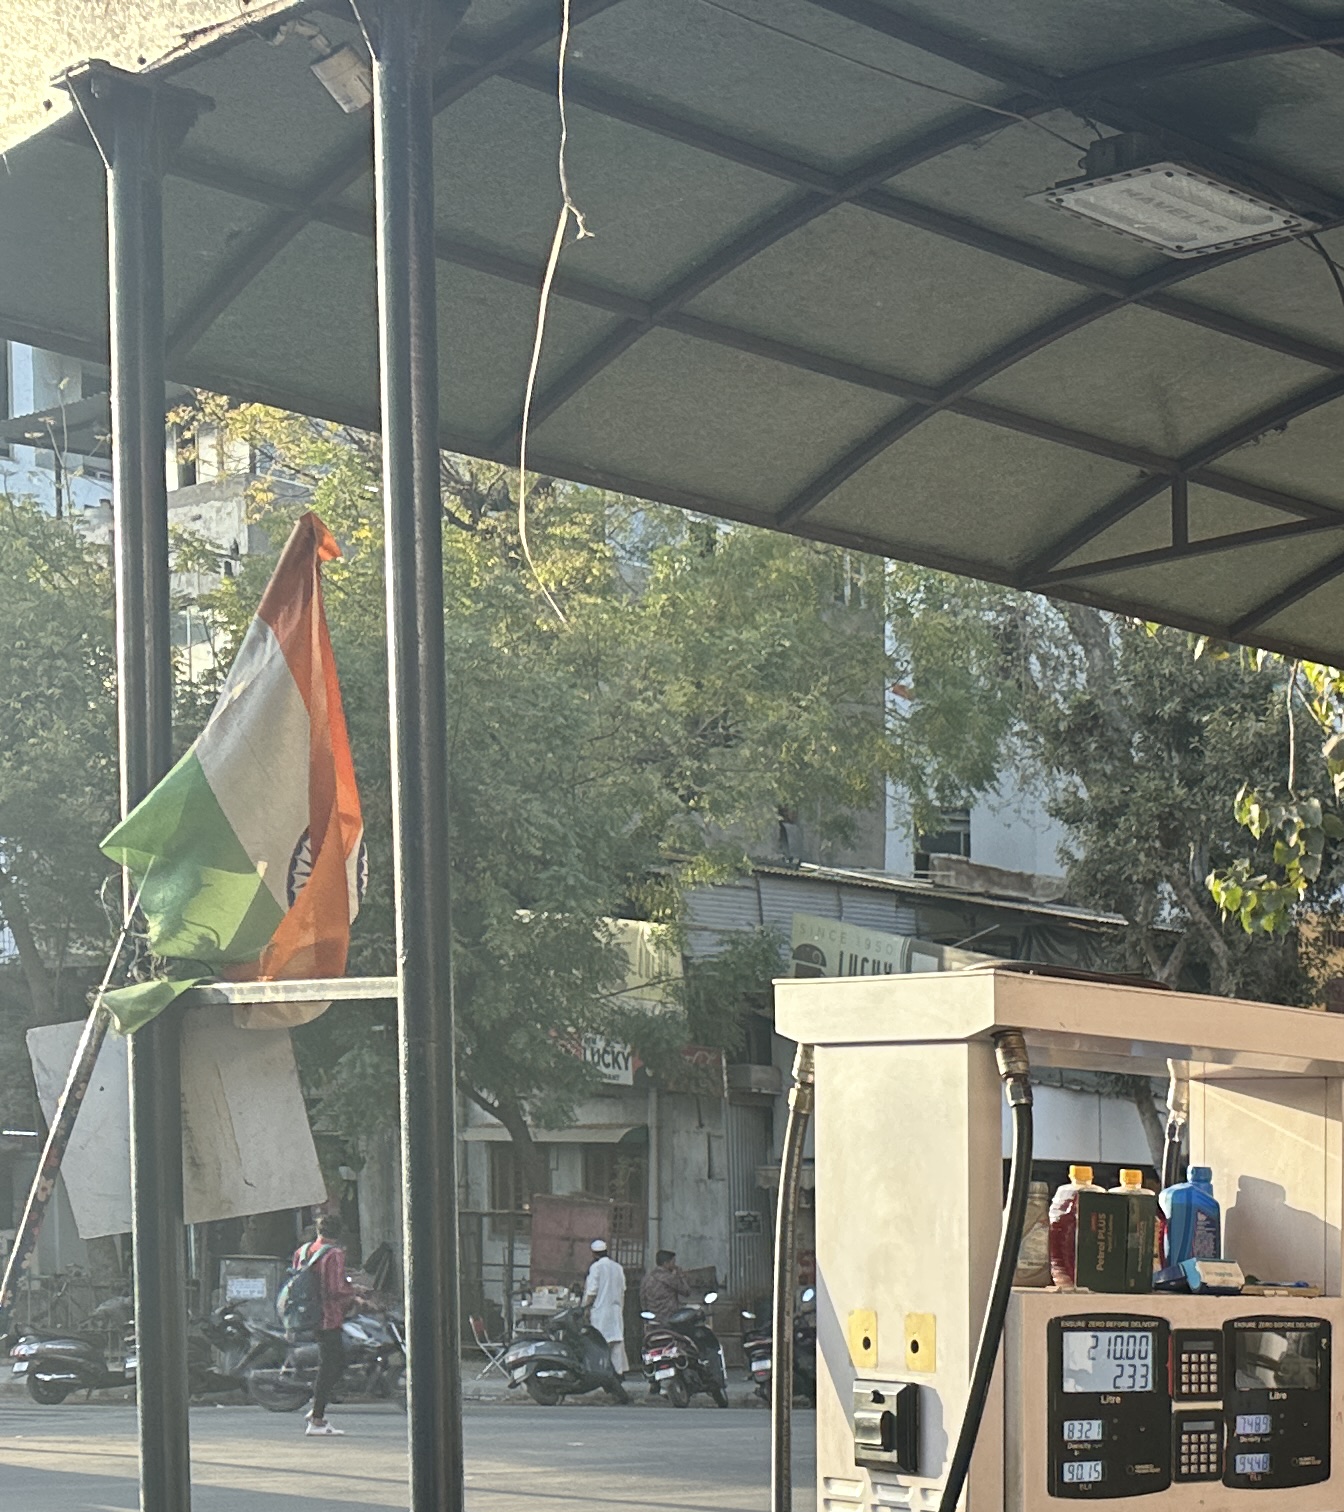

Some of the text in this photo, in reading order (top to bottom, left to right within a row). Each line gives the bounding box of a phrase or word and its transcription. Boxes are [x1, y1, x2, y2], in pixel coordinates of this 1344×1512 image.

[799, 922, 893, 956] SINCE 1950
[1095, 1212, 1107, 1271] Petrol PLUS
[1087, 1334, 1150, 1361] 210.00
[1100, 1394, 1121, 1405] Litre
[1067, 1461, 1101, 1482] 90.15
